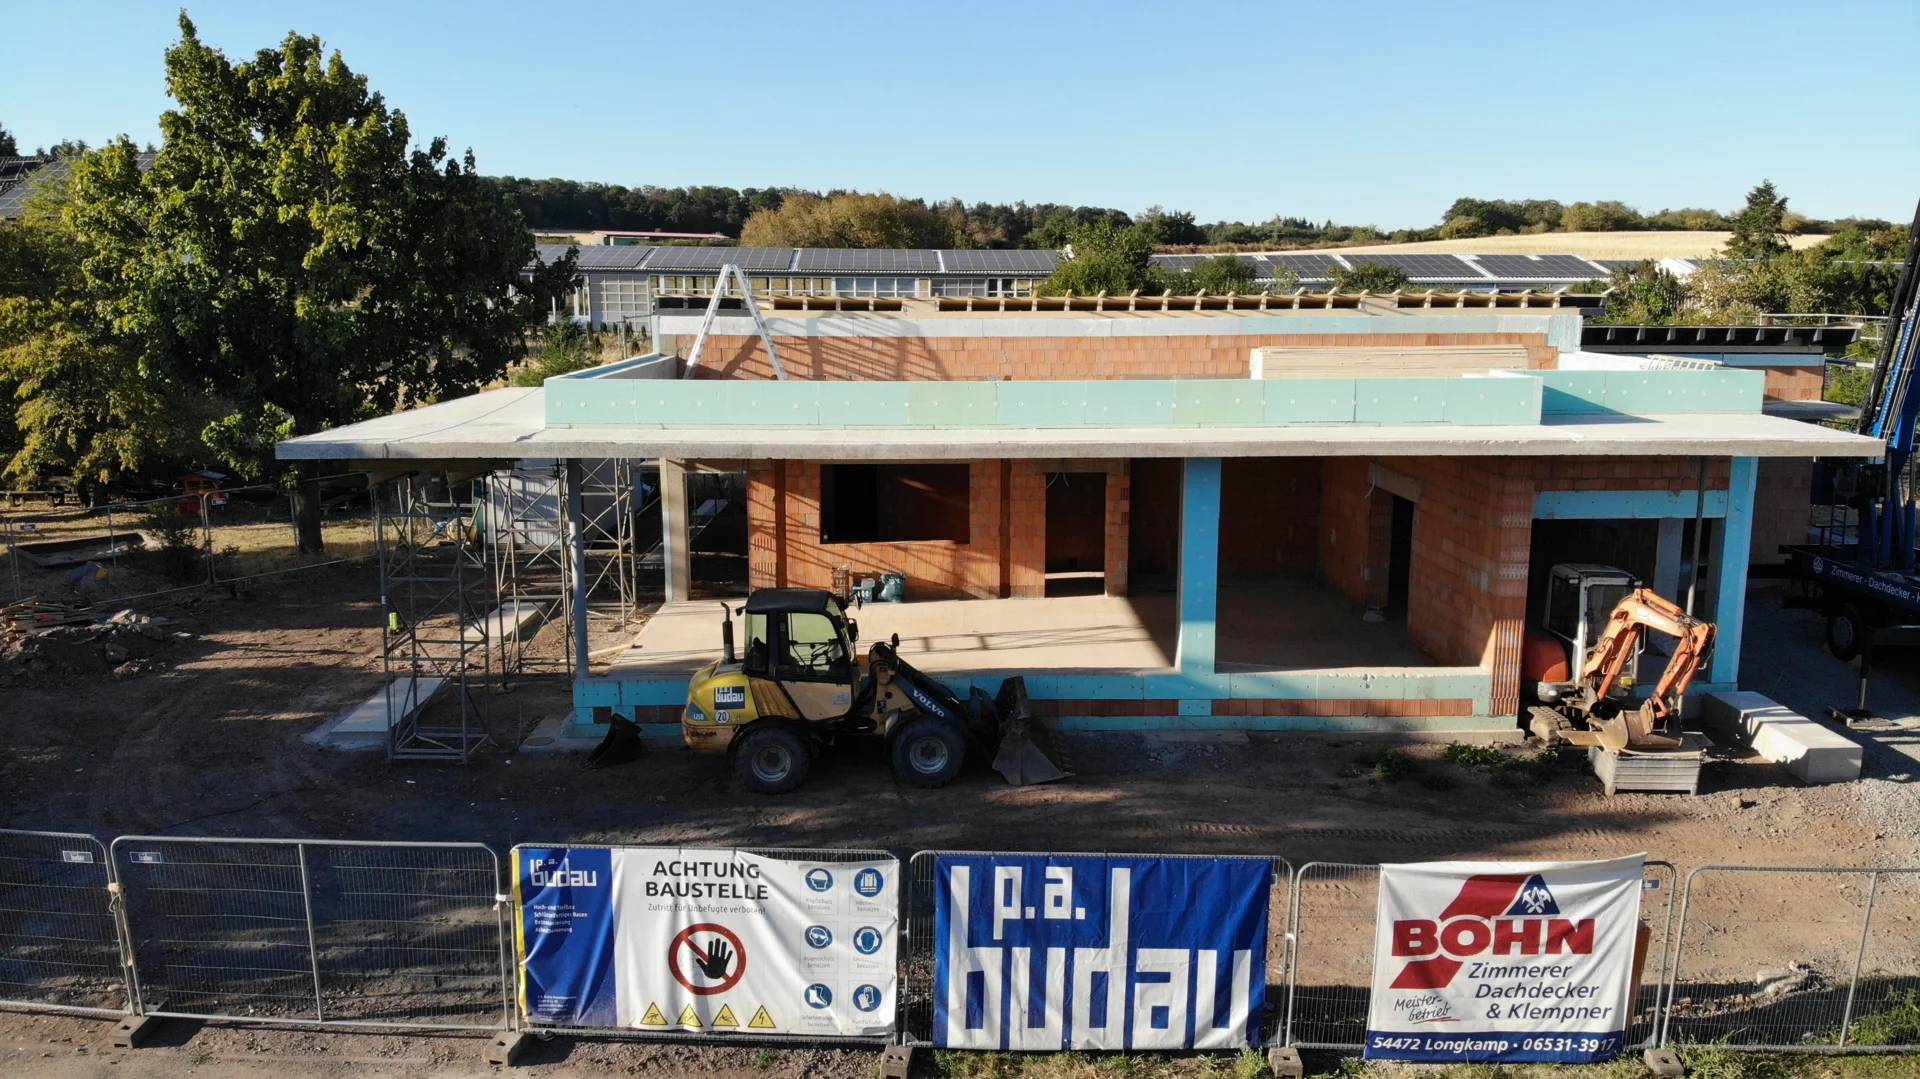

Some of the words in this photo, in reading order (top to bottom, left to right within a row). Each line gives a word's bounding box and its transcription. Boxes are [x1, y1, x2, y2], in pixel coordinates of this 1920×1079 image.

[1831, 565, 1862, 583] Zimmerer
[1868, 577, 1910, 599] Dachdecker
[716, 687, 743, 702] budau
[913, 688, 944, 717] VOLVO
[718, 712, 727, 722] 20
[530, 858, 596, 887] budau
[653, 861, 760, 878] ACHTUNG
[646, 882, 768, 899] BAUSTELLE
[648, 904, 672, 912] Zutritt
[675, 904, 686, 912] für
[688, 904, 728, 914] Unbefugte
[730, 906, 766, 915] verboten!
[993, 866, 1086, 940] p.a.
[1392, 918, 1595, 957] BOHN
[947, 866, 1252, 1050] budau
[1468, 962, 1572, 978] Zimmerer
[1475, 982, 1599, 998] Dachdecker
[1394, 994, 1442, 1012] Meister-
[1408, 1003, 1451, 1021] betrieb
[1486, 1004, 1500, 1019] &
[1508, 1002, 1612, 1023] Klempner
[1373, 1036, 1420, 1050] 54472
[1425, 1039, 1508, 1054] Longkamp
